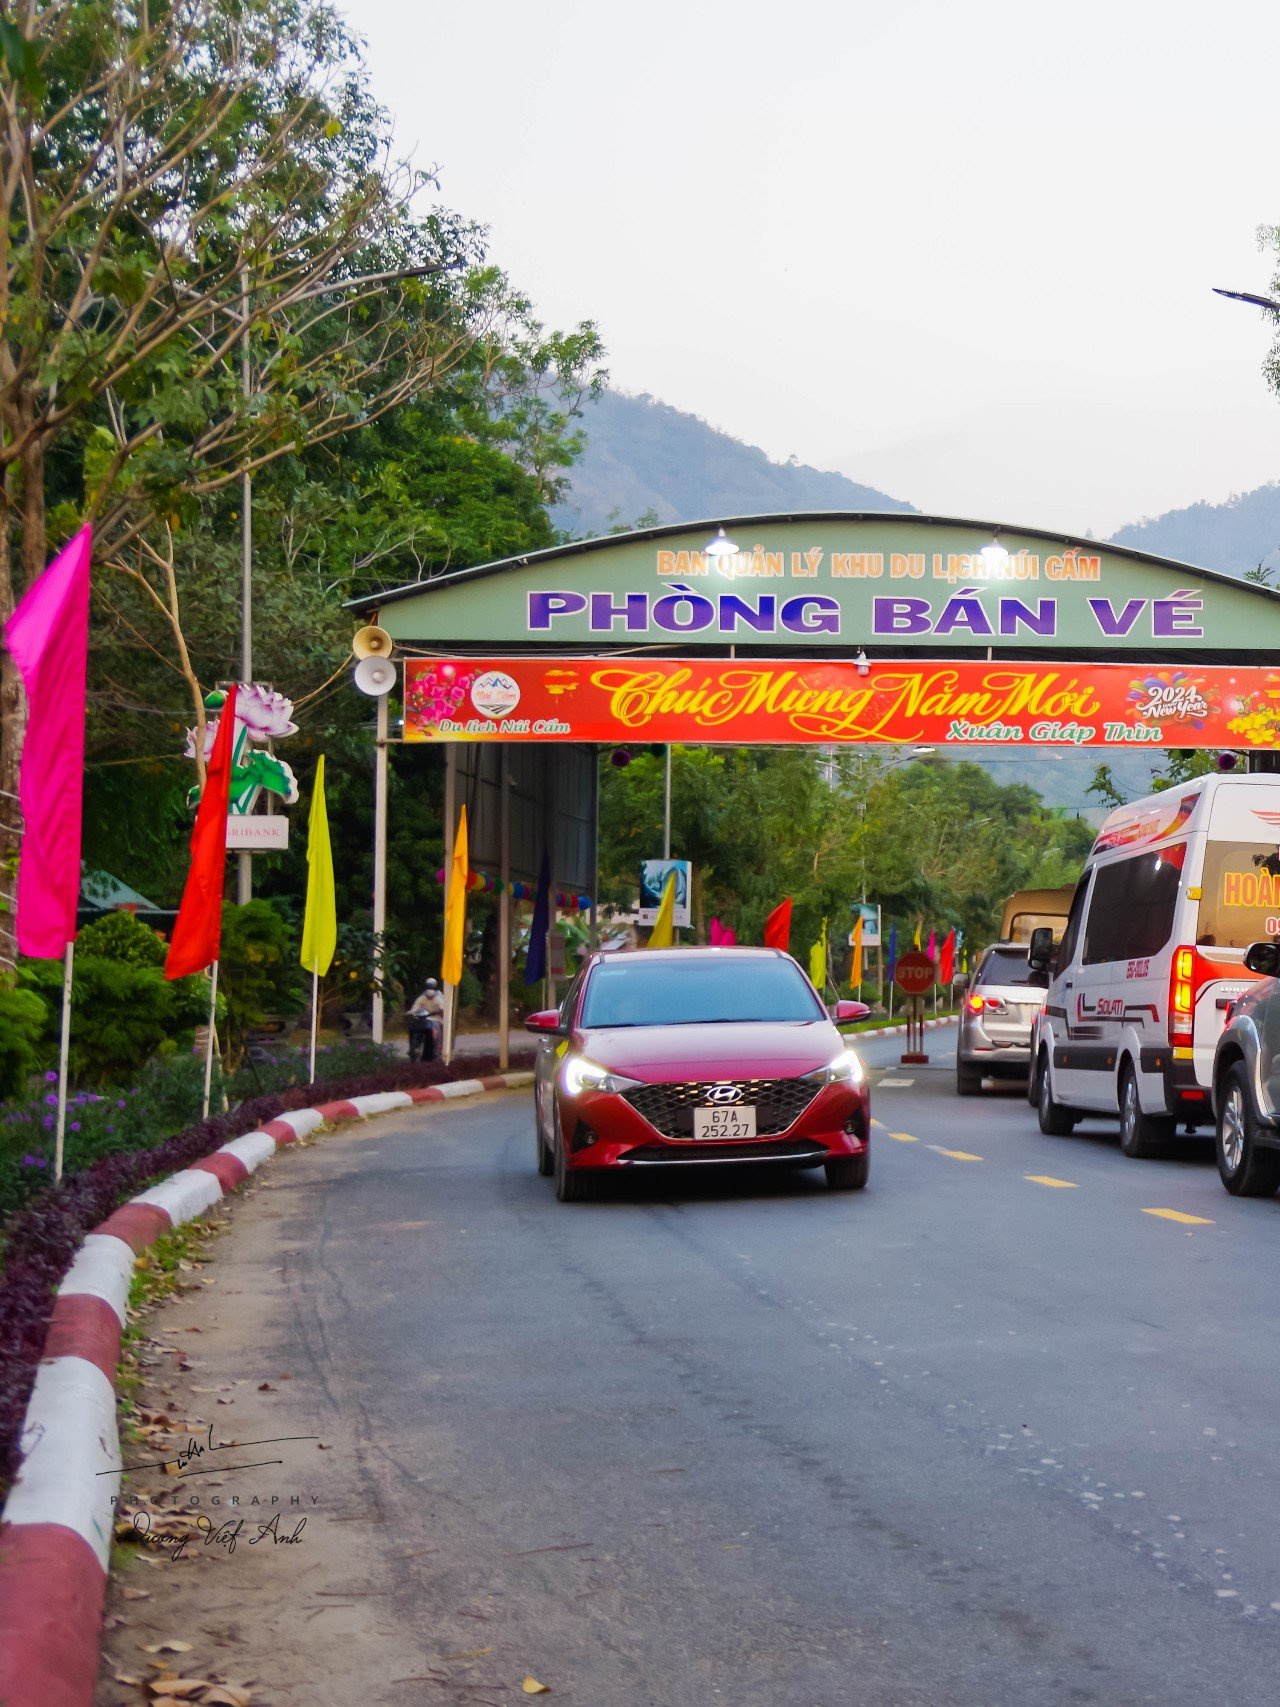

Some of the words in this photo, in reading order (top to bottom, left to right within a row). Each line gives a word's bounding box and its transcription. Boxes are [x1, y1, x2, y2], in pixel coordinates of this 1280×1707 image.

[657, 550, 709, 576] BAN
[716, 543, 784, 580] QUẢN
[791, 547, 824, 577] LÝ
[831, 552, 884, 578] KHU
[890, 553, 925, 579] DU
[933, 553, 990, 584] LỊCH
[1045, 547, 1100, 581] CẤM
[527, 582, 841, 634] PHÒNG
[872, 586, 1057, 637] BÁN
[1087, 589, 1204, 638] VÉ
[590, 668, 735, 727] Chúc
[695, 670, 876, 739] Mừng
[980, 671, 1101, 727] Mới
[1136, 686, 1203, 711] 2024
[1143, 704, 1177, 718] New
[1177, 699, 1208, 718] Year
[440, 719, 462, 733] Du
[946, 719, 1024, 742] Xuân
[1030, 719, 1096, 745] Giáp
[1102, 721, 1163, 743] Thìn
[898, 966, 934, 979] STOP
[712, 1110, 738, 1123] 67A
[701, 1123, 750, 1138] 252.27
